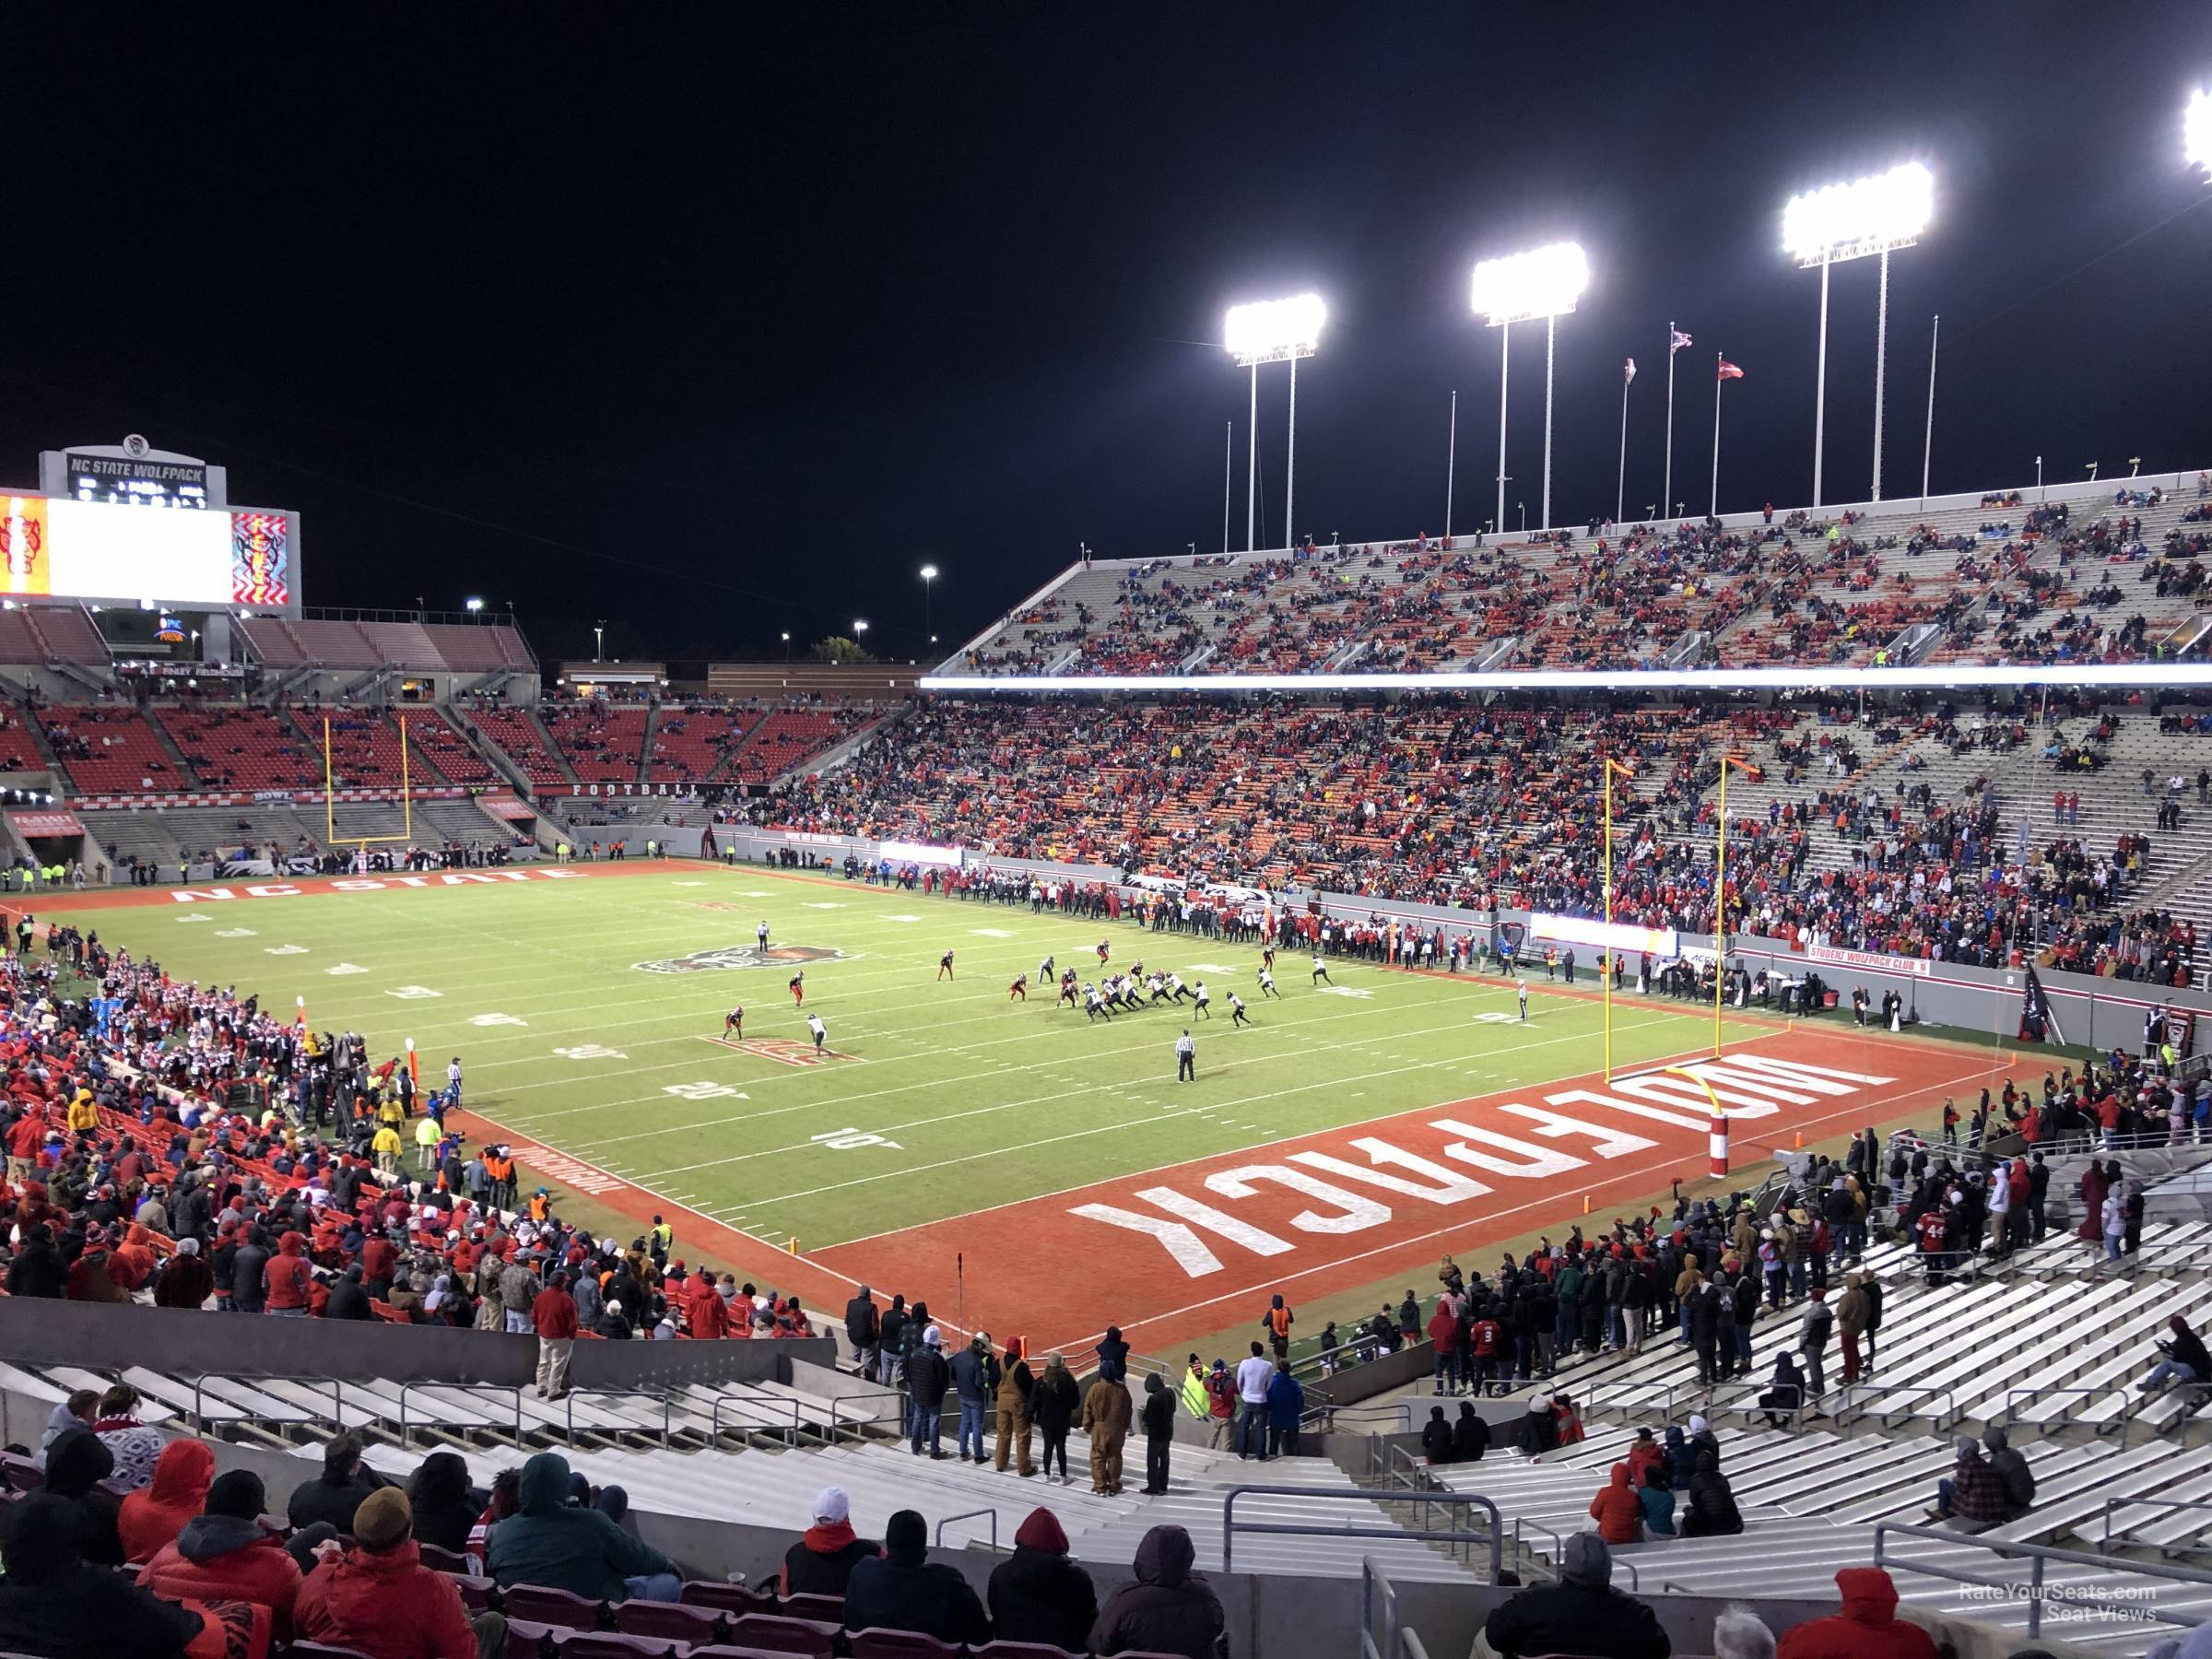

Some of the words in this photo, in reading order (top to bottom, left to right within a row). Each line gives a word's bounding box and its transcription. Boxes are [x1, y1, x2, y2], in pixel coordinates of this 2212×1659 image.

[71, 458, 90, 471] NC
[93, 460, 131, 476] STATE
[134, 464, 203, 482] WOLFPACK
[167, 618, 182, 629] PNC
[195, 668, 244, 677] FIELDHOUSE
[254, 791, 293, 801] BOWL
[572, 783, 698, 796] FOOTBALL
[170, 885, 302, 903] NC
[330, 868, 591, 891] STATE
[1811, 947, 1844, 960] STUDENT
[1847, 952, 1890, 967] WOLFPACK
[1892, 959, 1914, 971] CLUB
[2006, 975, 2014, 985] 8
[661, 1081, 739, 1100] 20
[810, 1127, 886, 1150] 10
[1065, 1053, 1900, 1279] WOLFPACK
[1484, 1330, 1493, 1343] 9
